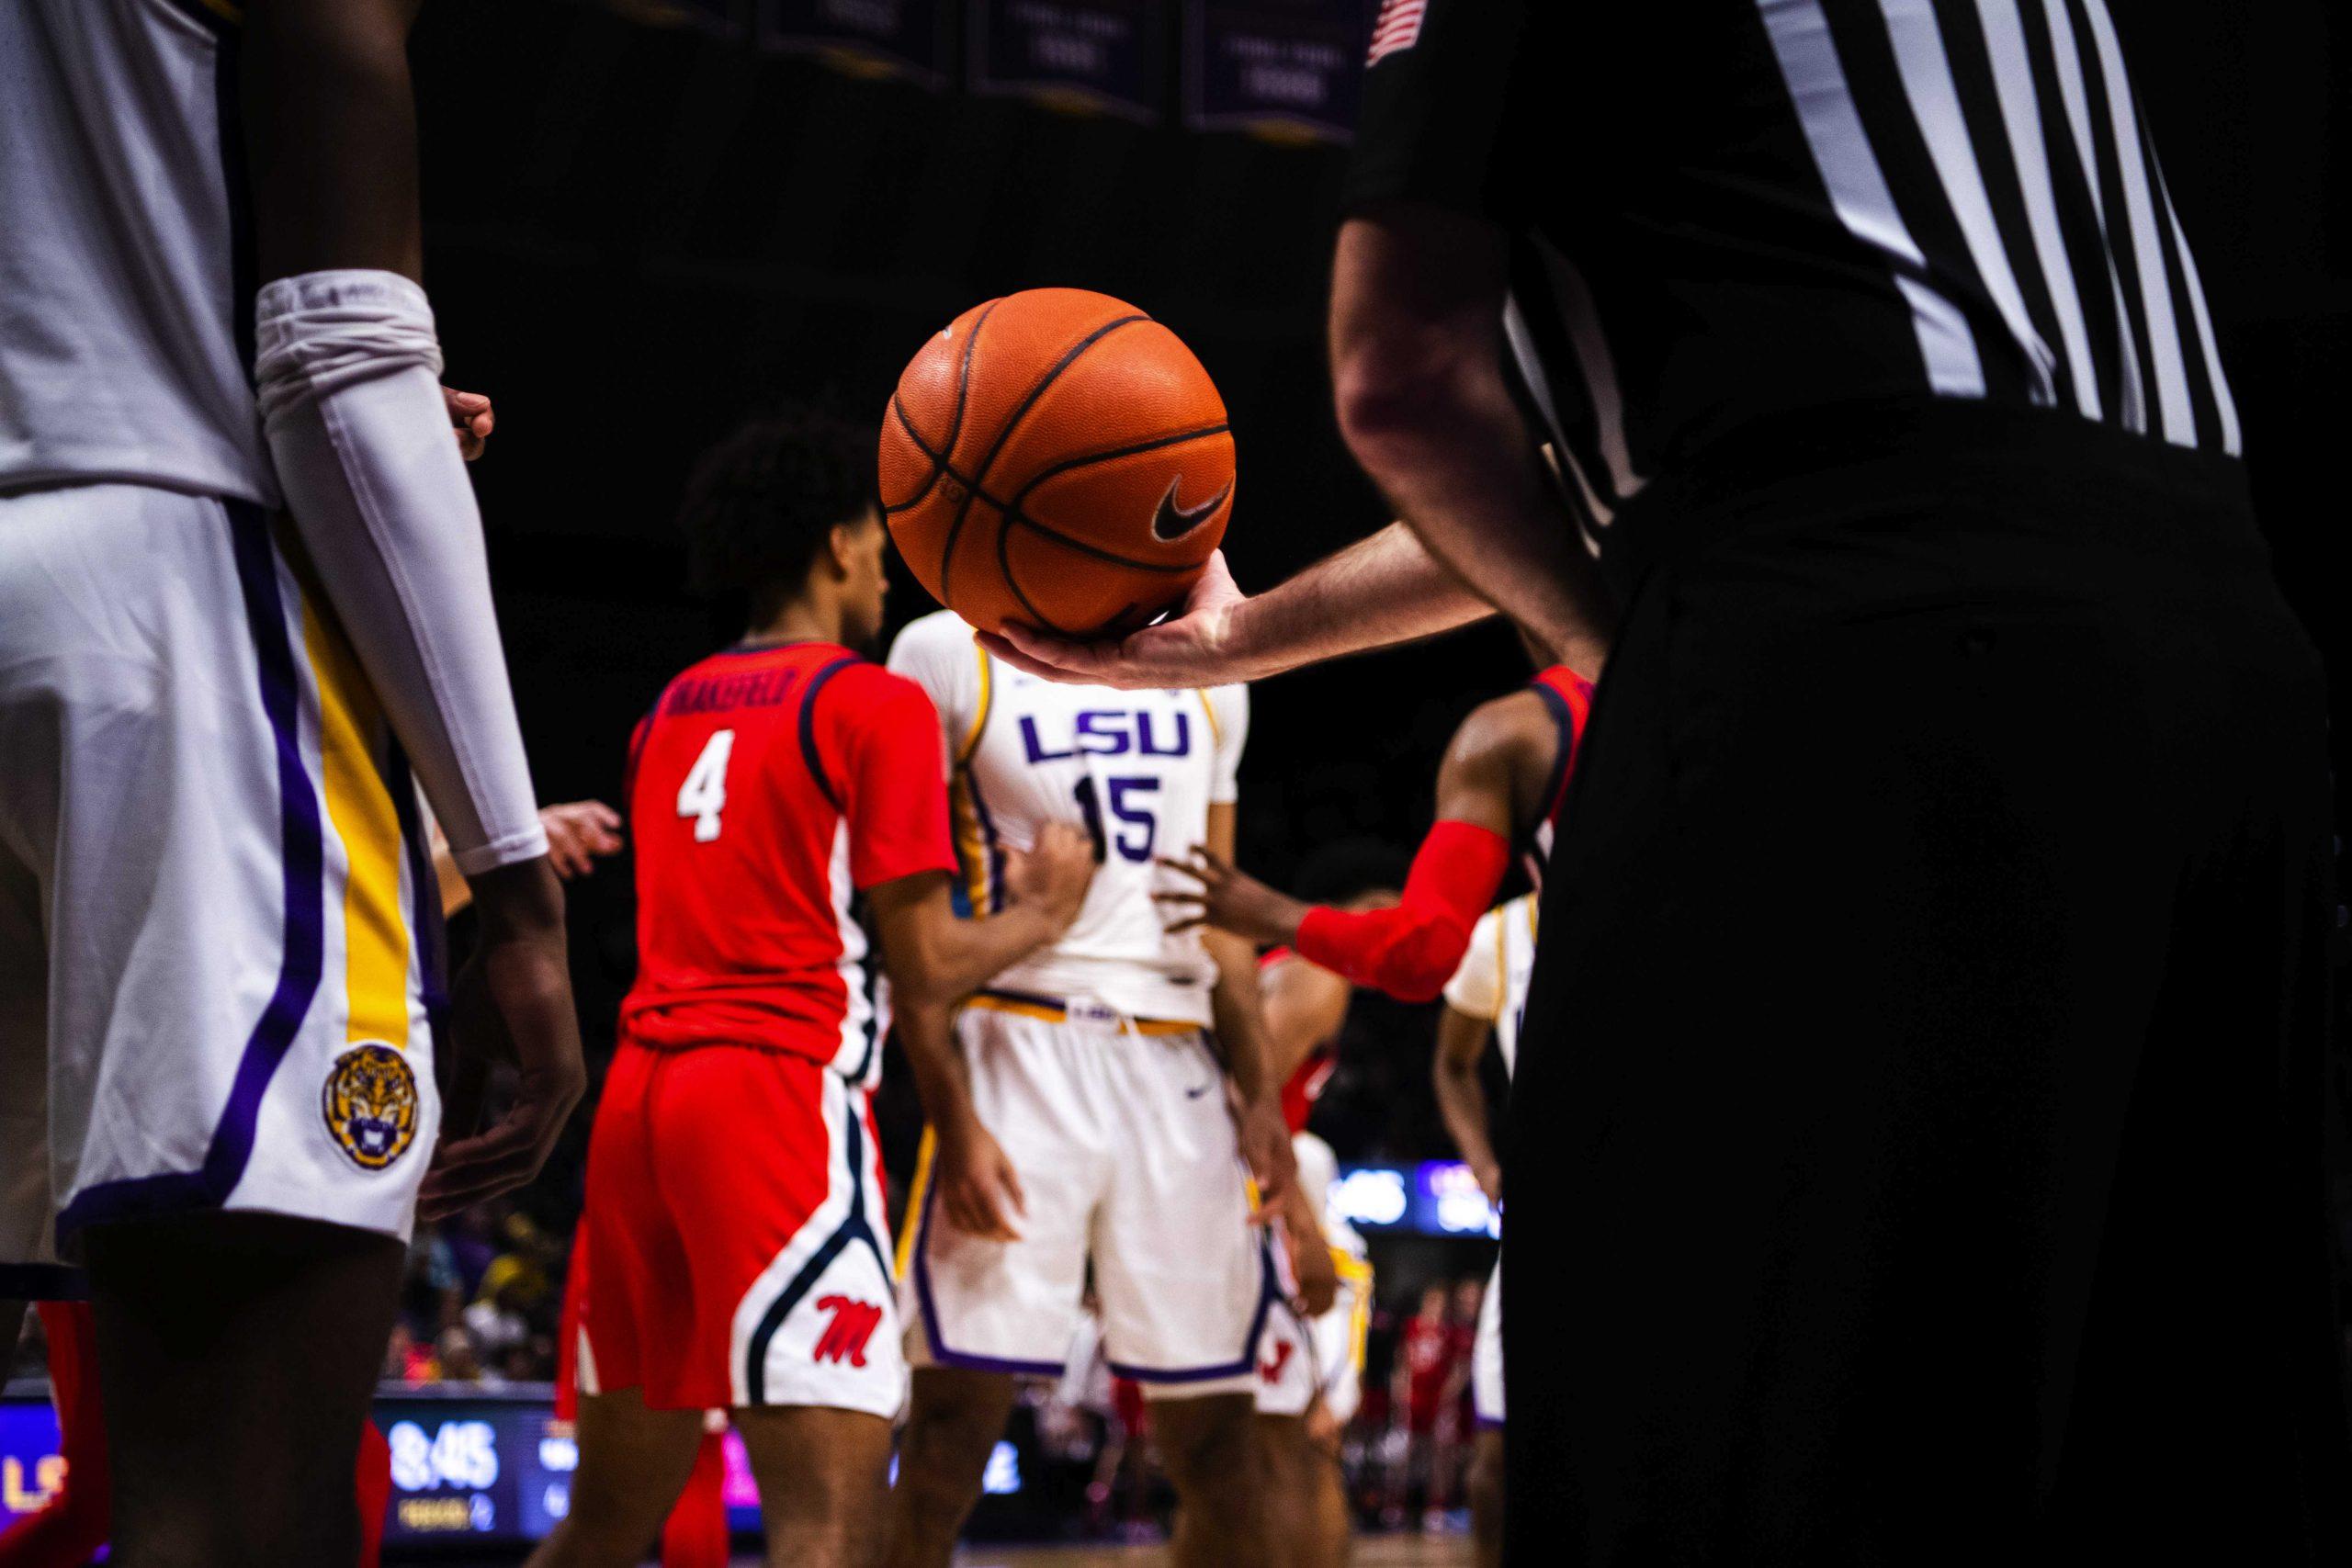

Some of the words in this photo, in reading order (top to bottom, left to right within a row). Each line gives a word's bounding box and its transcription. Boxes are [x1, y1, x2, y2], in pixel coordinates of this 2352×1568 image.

[1019, 710, 1189, 764] LSU
[676, 728, 735, 842] 4
[1074, 776, 1159, 864] 15
